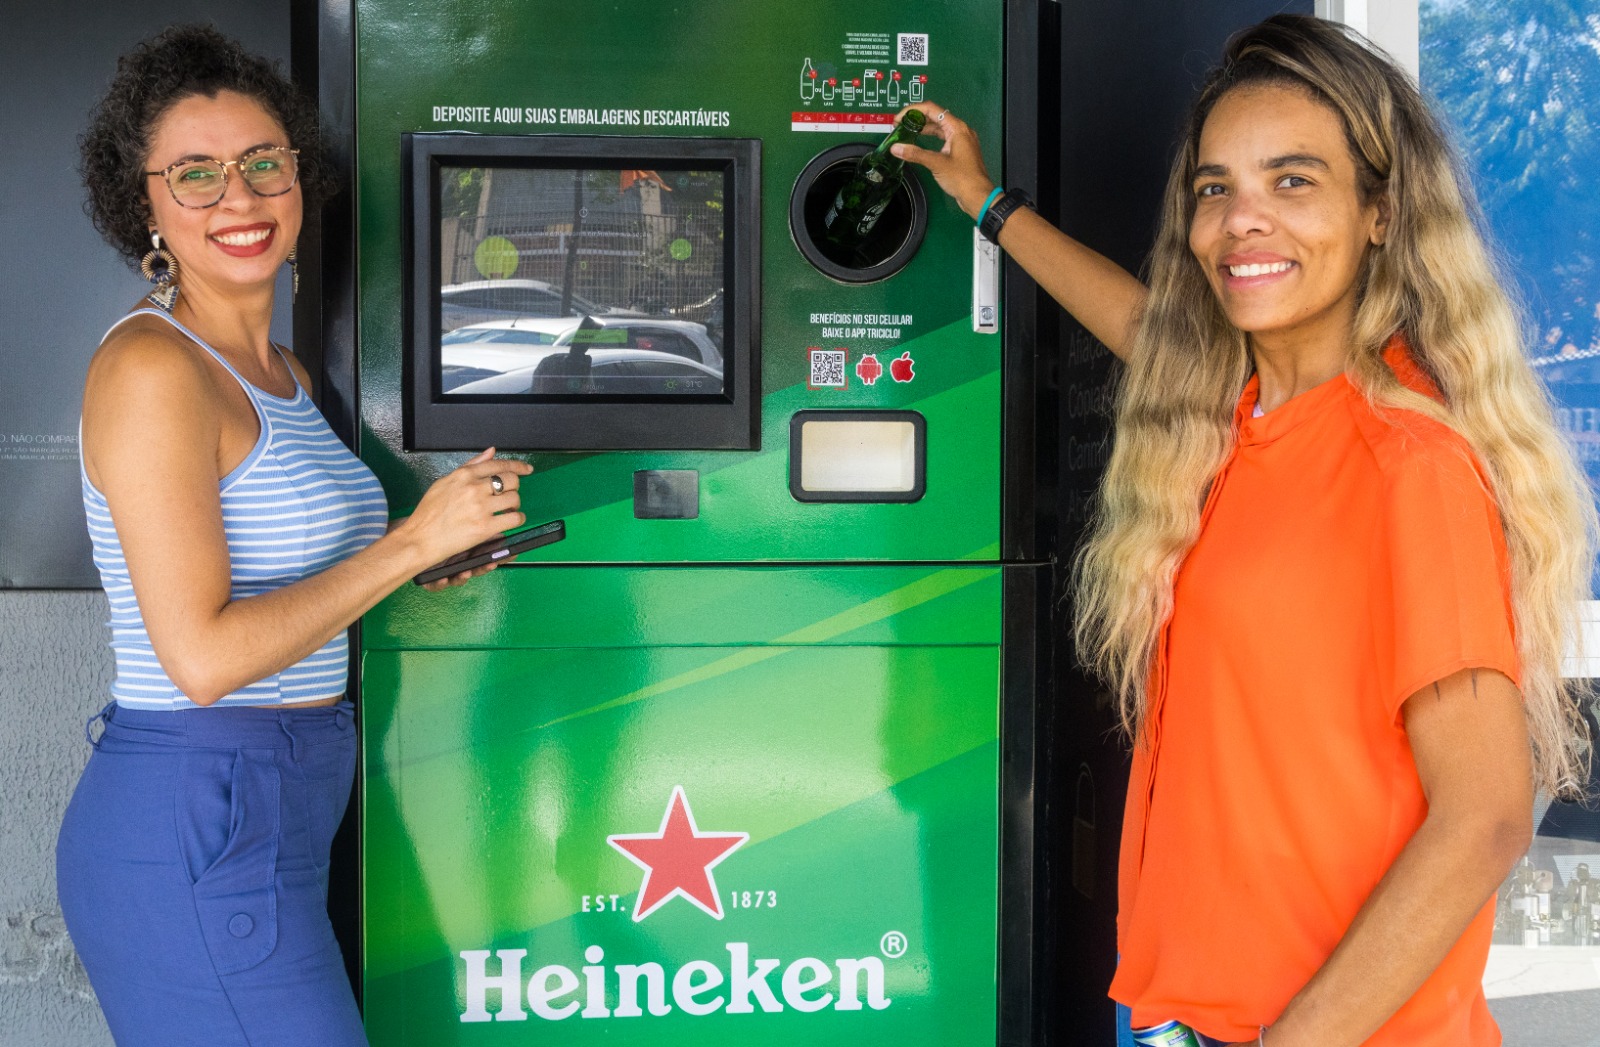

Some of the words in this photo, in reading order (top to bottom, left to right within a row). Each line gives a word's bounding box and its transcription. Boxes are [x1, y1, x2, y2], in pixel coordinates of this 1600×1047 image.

[432, 105, 491, 123] DEPOSITE
[494, 107, 523, 124] AQUI
[525, 107, 557, 124] SUAS
[560, 108, 641, 126] EMBALAGENS
[643, 107, 730, 127] DESCARTÁVEIS
[810, 311, 852, 324] BENEFÍCIOS
[852, 314, 863, 324] NO
[864, 314, 879, 325] SEU
[879, 314, 913, 326] CELULAR!
[822, 327, 844, 338] BAIXE
[845, 328, 851, 338] O
[851, 328, 866, 338] APP
[867, 328, 901, 339] TRICICLO!
[11, 433, 33, 443] NÃO
[581, 895, 626, 912] EST.
[731, 890, 777, 908] 1873
[459, 942, 892, 1023] Heineken
